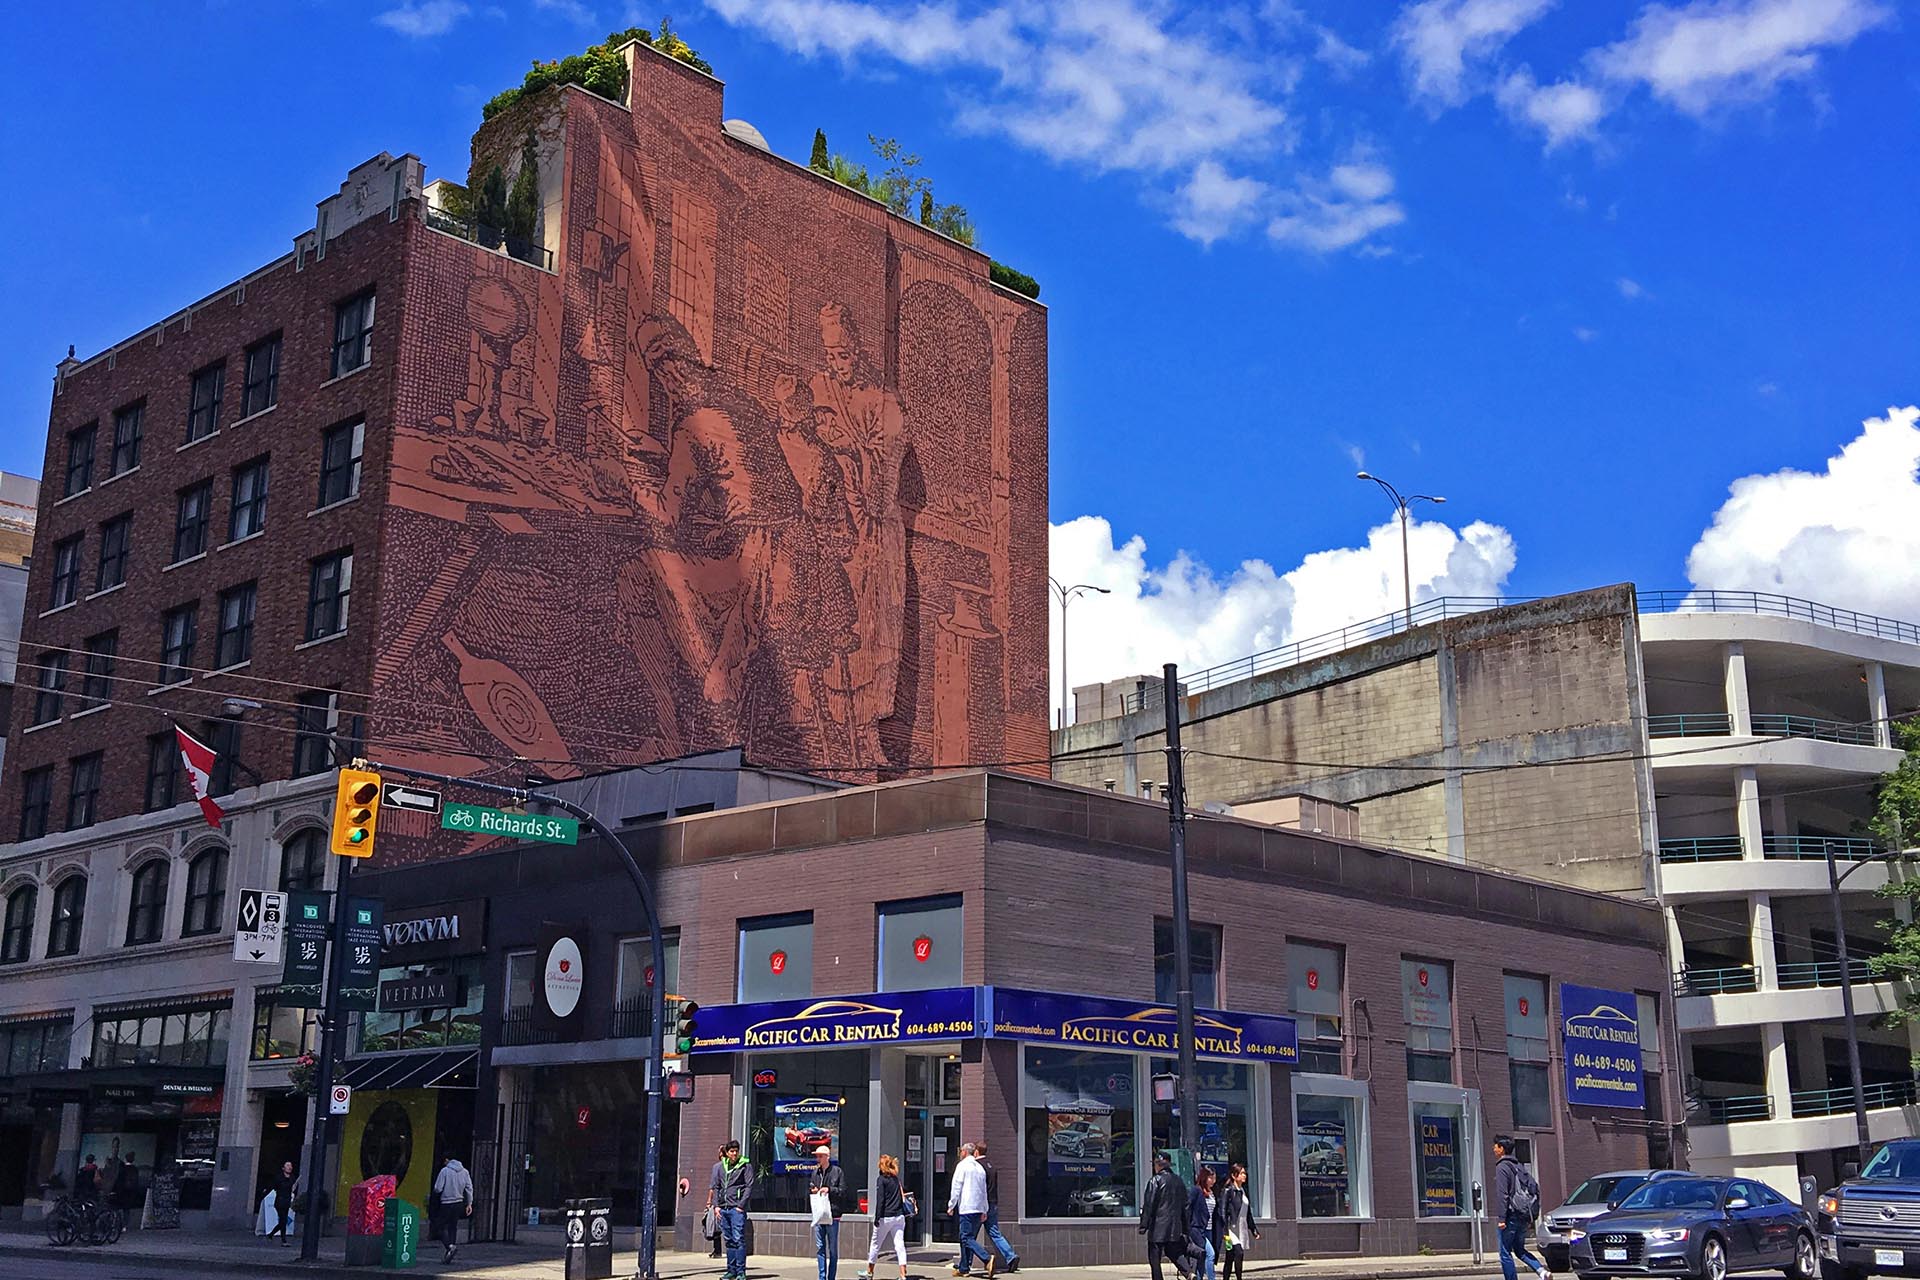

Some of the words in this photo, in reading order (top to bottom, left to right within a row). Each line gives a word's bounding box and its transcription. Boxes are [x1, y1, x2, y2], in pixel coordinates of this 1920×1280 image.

[480, 812, 543, 836] Richards
[546, 821, 566, 839] St.
[268, 911, 276, 920] 3
[385, 986, 445, 1002] VETRINA
[744, 1029, 798, 1046] PACIFIC
[800, 1027, 831, 1042] CAR
[834, 1023, 900, 1041] RENTALS
[906, 1021, 973, 1035] 604-689-4506
[994, 1021, 1056, 1036] pacificcarrentals.com
[1061, 1023, 1129, 1044] PACIFIC
[1132, 1029, 1169, 1048] CAR
[1566, 1023, 1593, 1039] PACIFIC
[1594, 1026, 1609, 1040] CAR
[1609, 1028, 1638, 1044] RENTALS
[1247, 1044, 1296, 1057] 604-689-4506
[1574, 1053, 1636, 1072] 604-689-4506
[754, 1074, 776, 1084] OPEN
[1575, 1073, 1637, 1091] pacificcarrentals.com
[814, 1105, 838, 1113] RENTALS
[1423, 1124, 1439, 1138] CAR
[1424, 1143, 1453, 1157] RENTAL
[785, 1164, 798, 1172] Sport
[401, 1213, 412, 1262] metro
